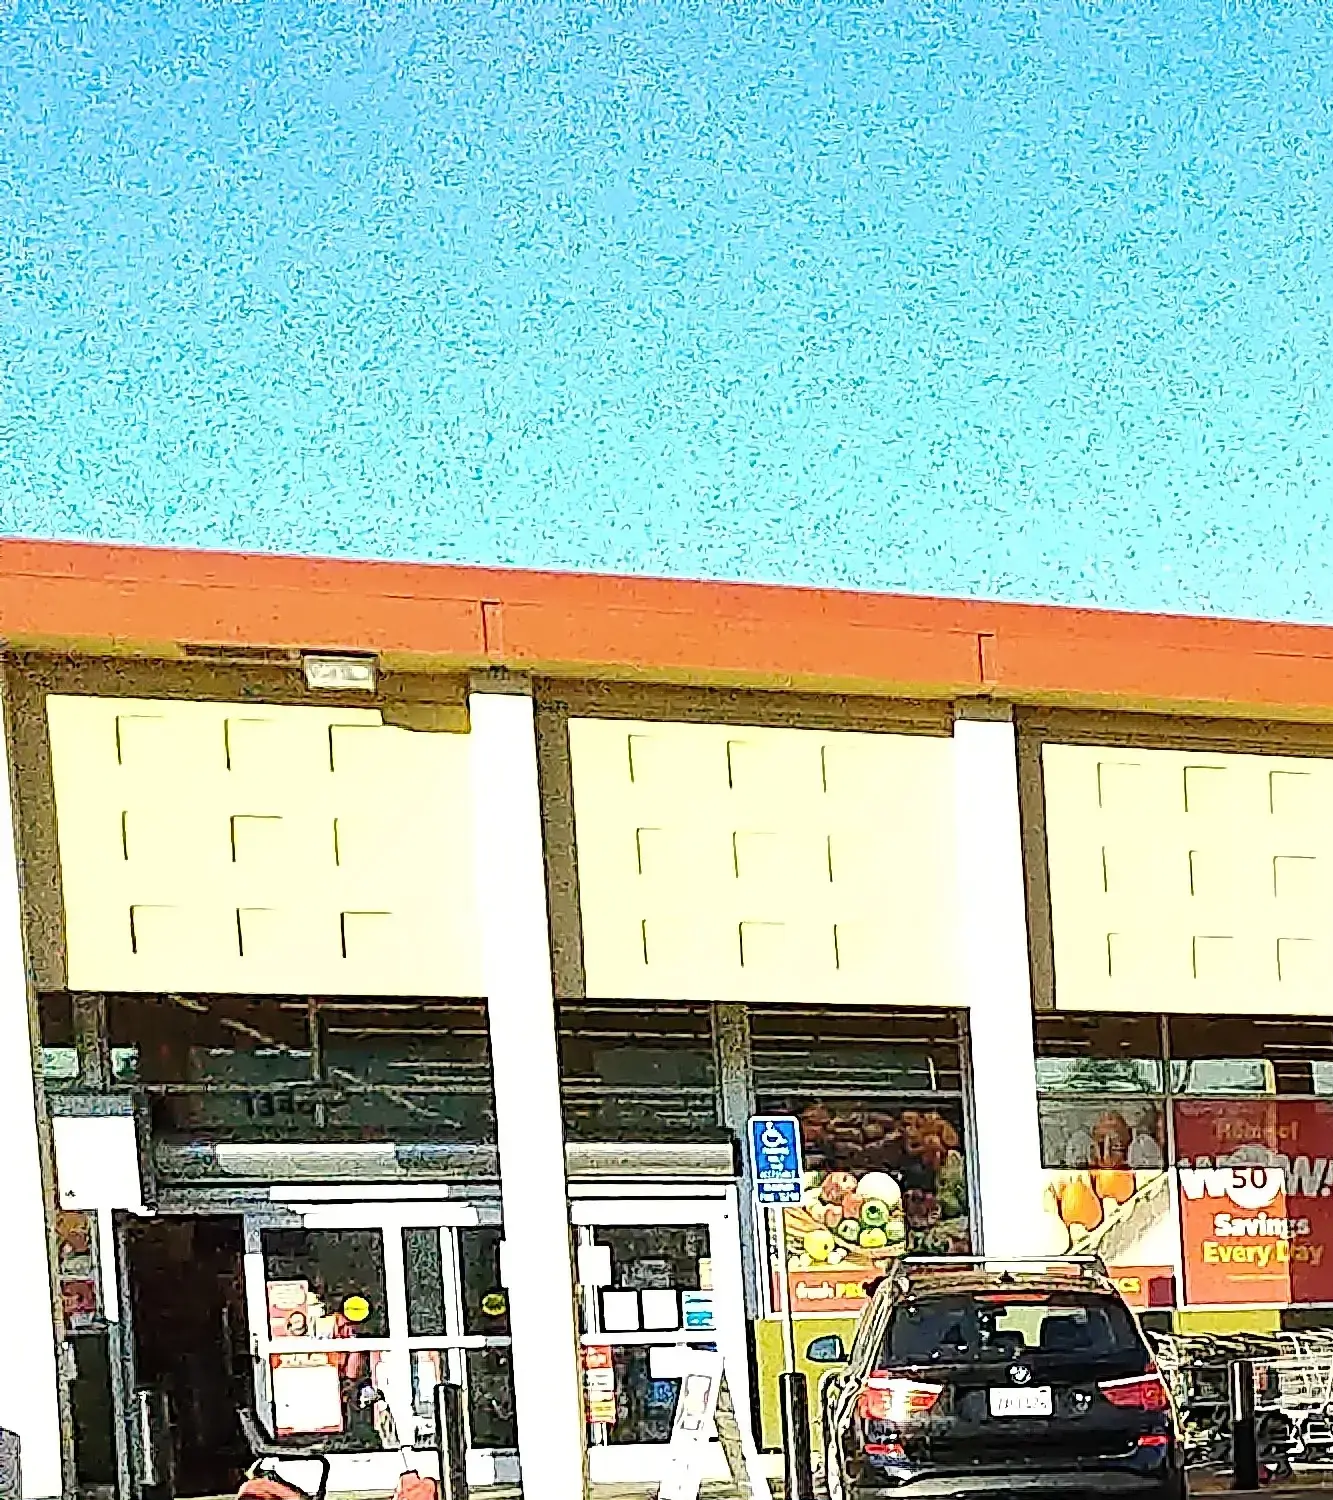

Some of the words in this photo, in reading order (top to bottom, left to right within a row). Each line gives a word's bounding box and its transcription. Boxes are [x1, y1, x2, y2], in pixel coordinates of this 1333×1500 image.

[1213, 1211, 1312, 1239] Savings
[1203, 1241, 1271, 1267] Every
[1274, 1241, 1325, 1267] Day
